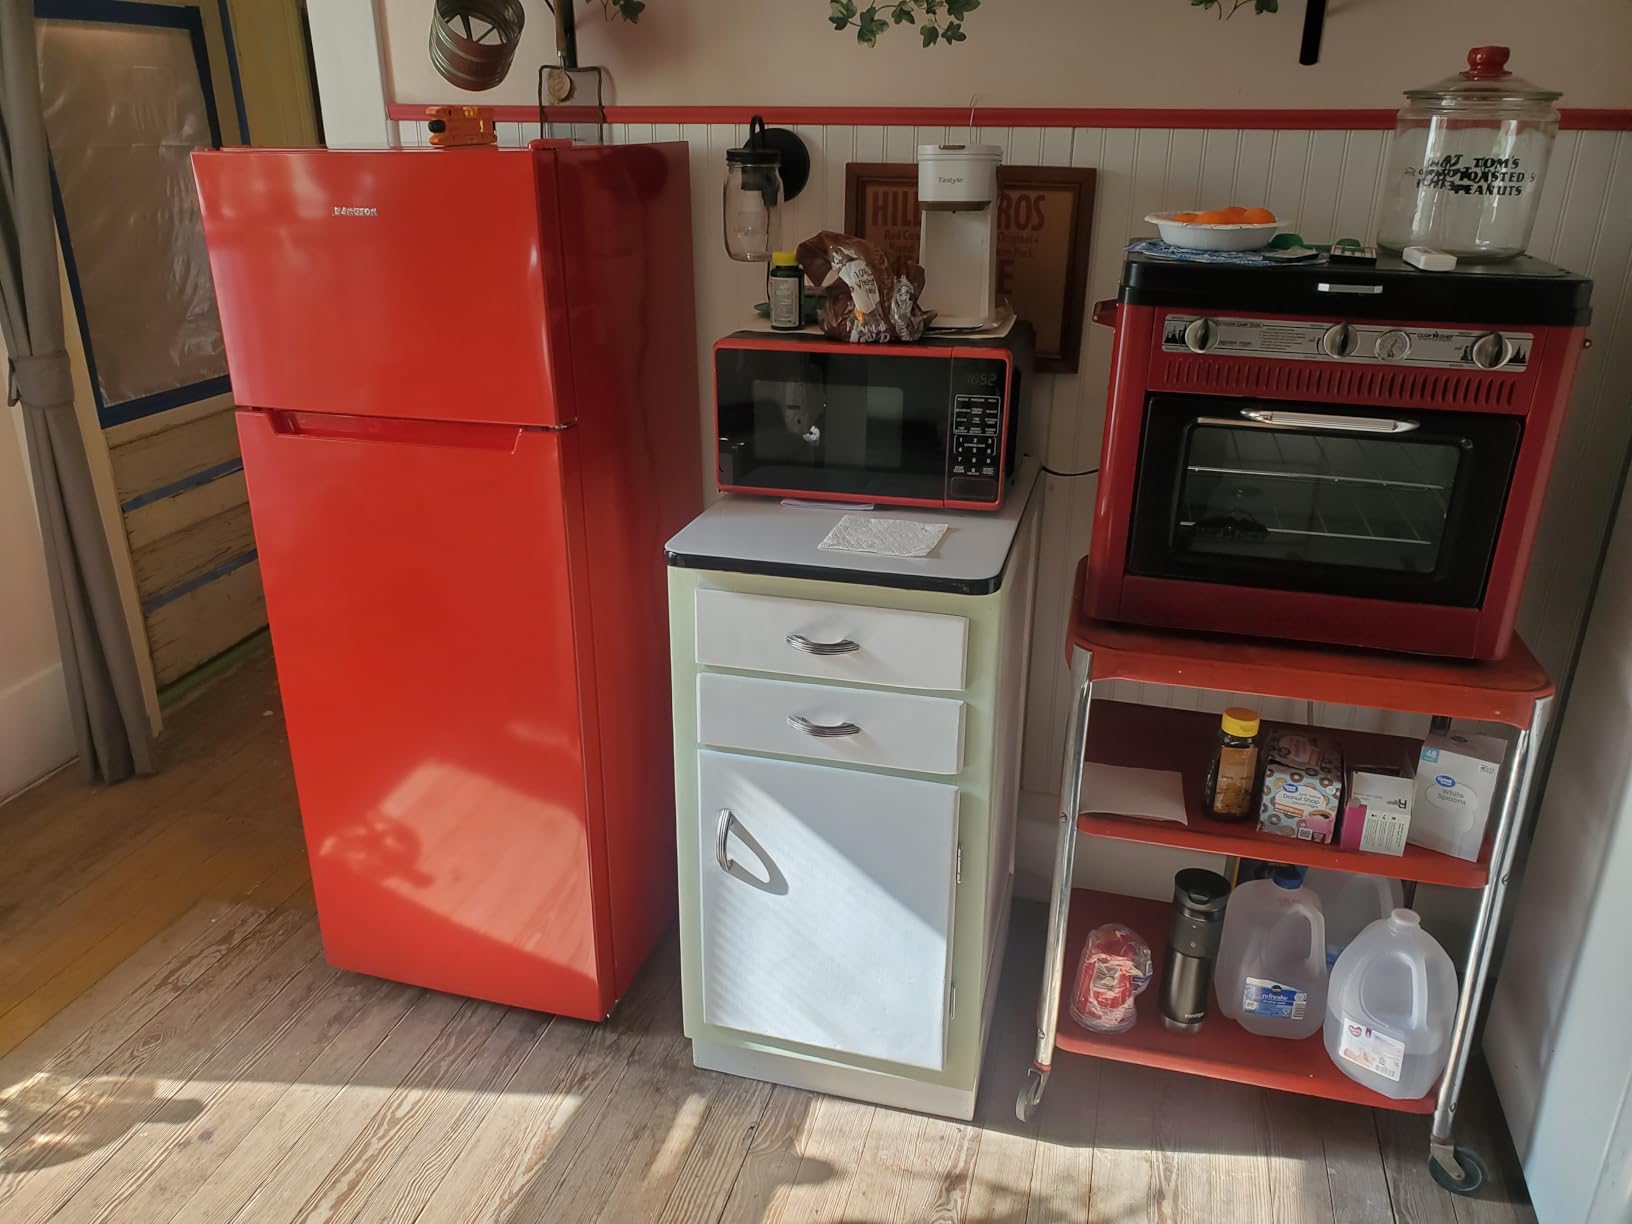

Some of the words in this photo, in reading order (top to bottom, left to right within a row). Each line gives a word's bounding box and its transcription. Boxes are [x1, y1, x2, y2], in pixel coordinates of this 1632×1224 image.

[1473, 155, 1520, 169] TOM'S
[938, 176, 964, 185] Tastyle
[1459, 170, 1525, 183] TOASTED
[1454, 184, 1522, 196] PEANUTS
[872, 191, 919, 226] HILL
[997, 193, 1046, 231] ROS
[1425, 749, 1437, 759] 48
[1282, 793, 1303, 801] Donut
[1303, 796, 1320, 805] Shop
[1438, 793, 1467, 806] Spoons
[1442, 788, 1465, 799] White
